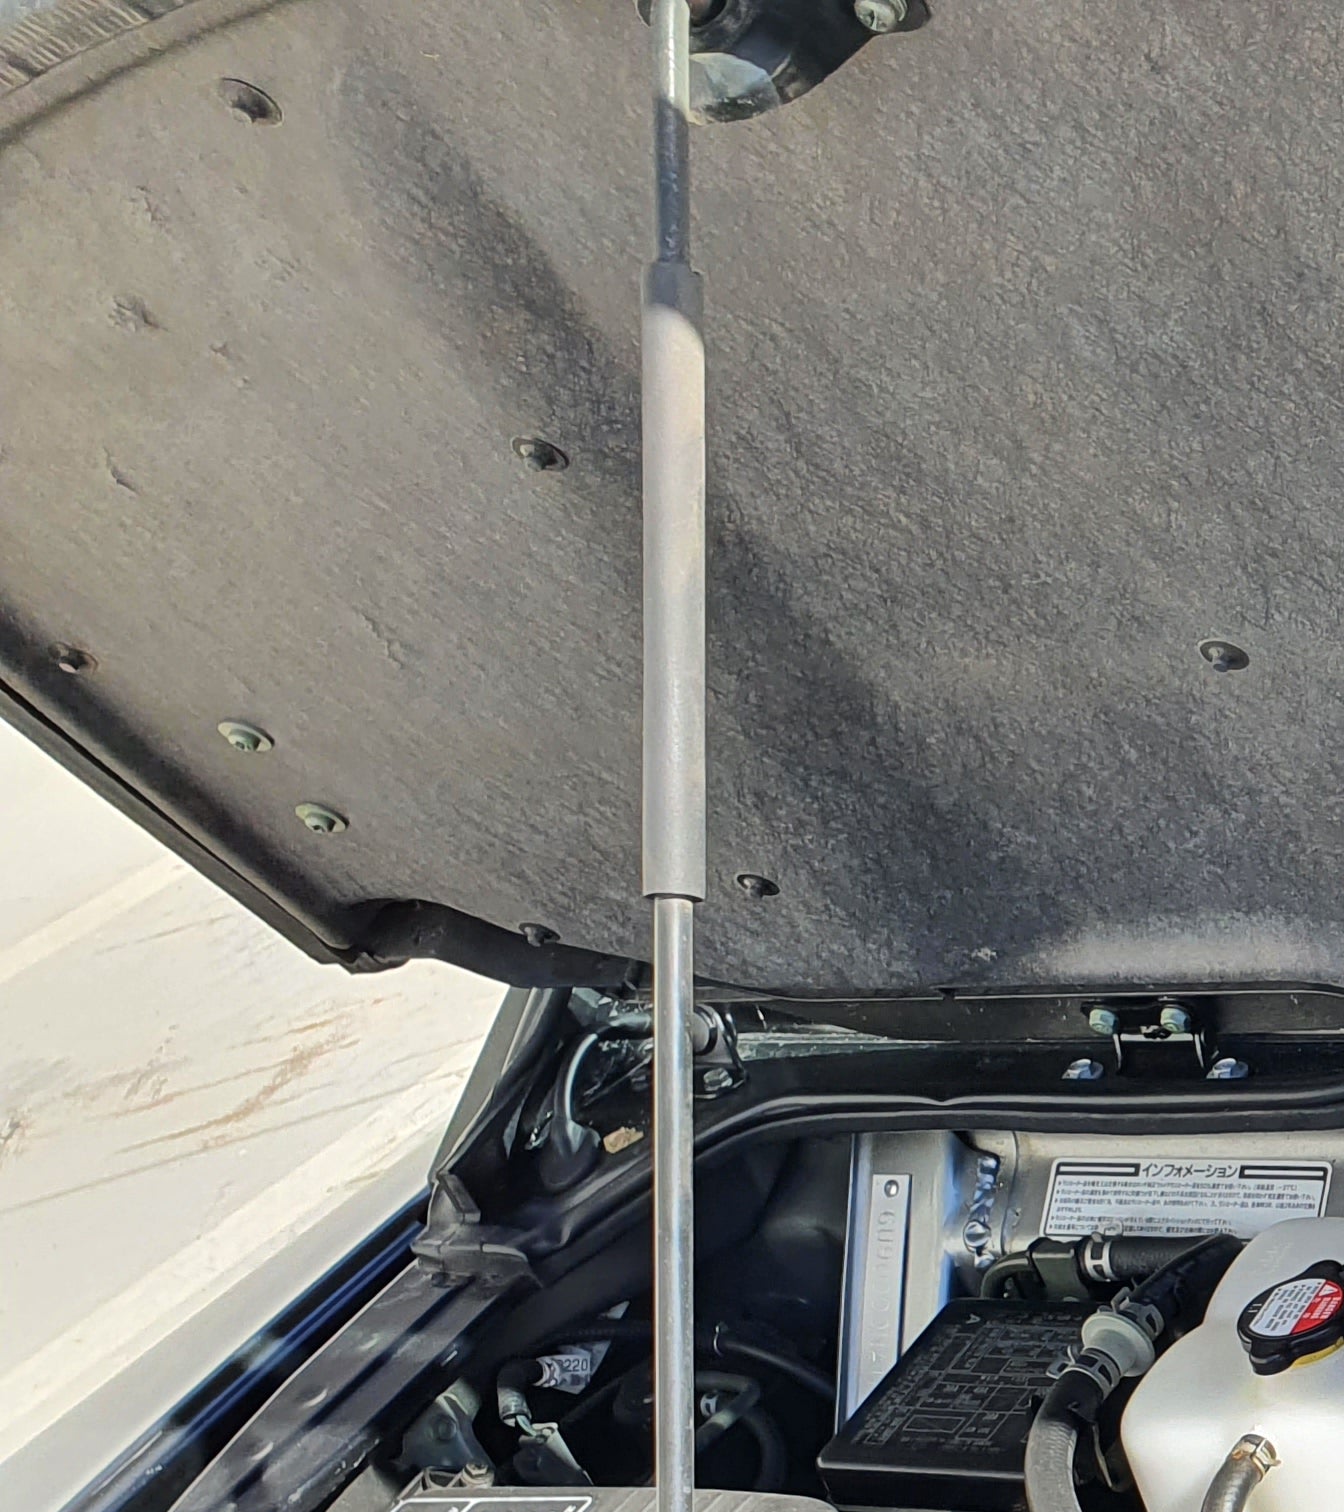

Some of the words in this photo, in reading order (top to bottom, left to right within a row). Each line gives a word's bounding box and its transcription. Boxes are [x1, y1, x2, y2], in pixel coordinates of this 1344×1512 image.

[1142, 1163, 1240, 1178] インフォメーション
